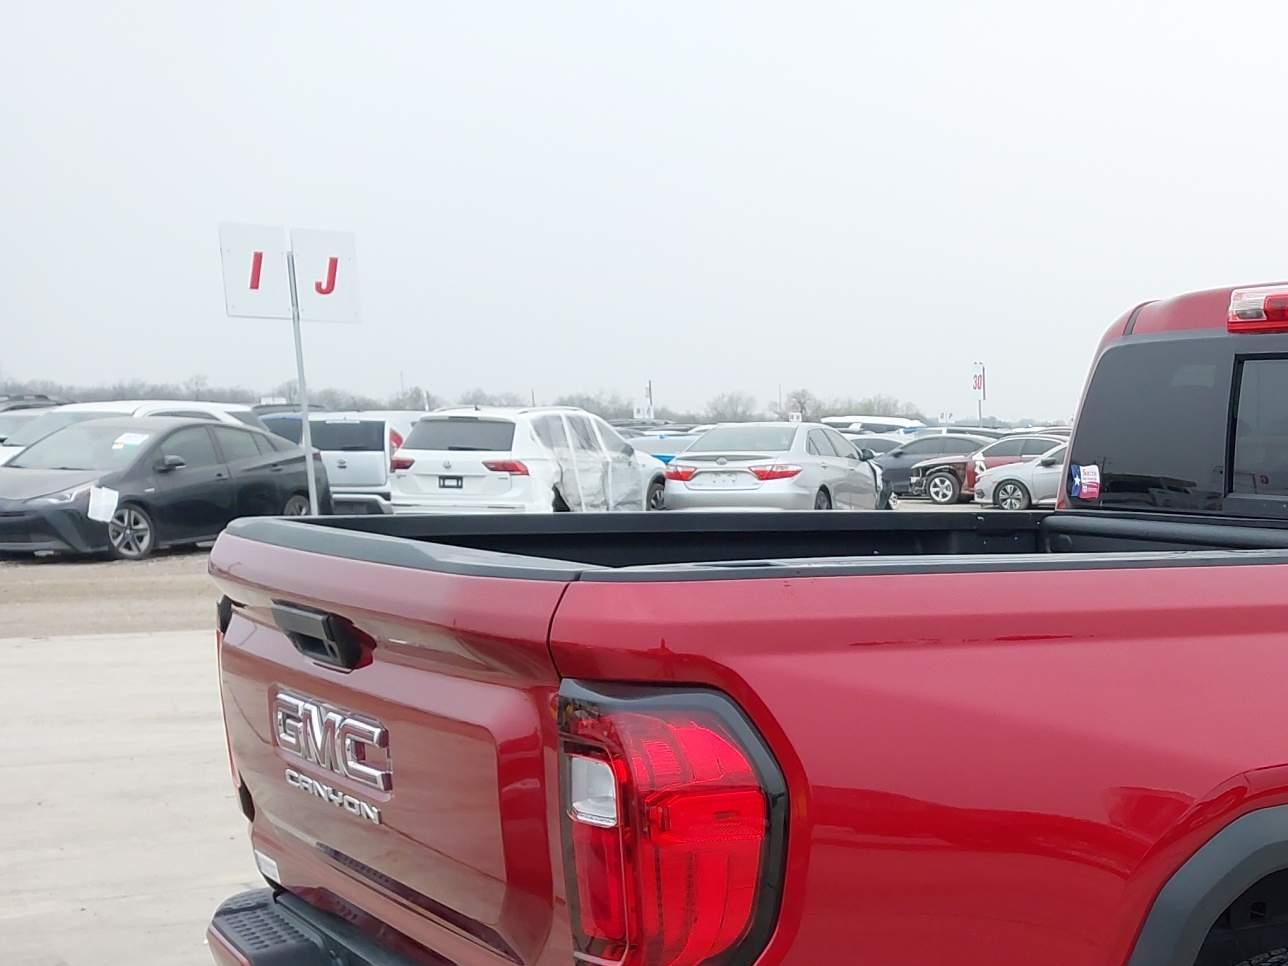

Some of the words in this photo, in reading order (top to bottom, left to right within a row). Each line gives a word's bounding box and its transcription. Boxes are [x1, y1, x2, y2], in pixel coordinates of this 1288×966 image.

[249, 251, 263, 290] I
[314, 256, 338, 295] J
[972, 374, 983, 390] 30
[272, 692, 393, 792] GMC
[284, 768, 383, 825] CANYON
